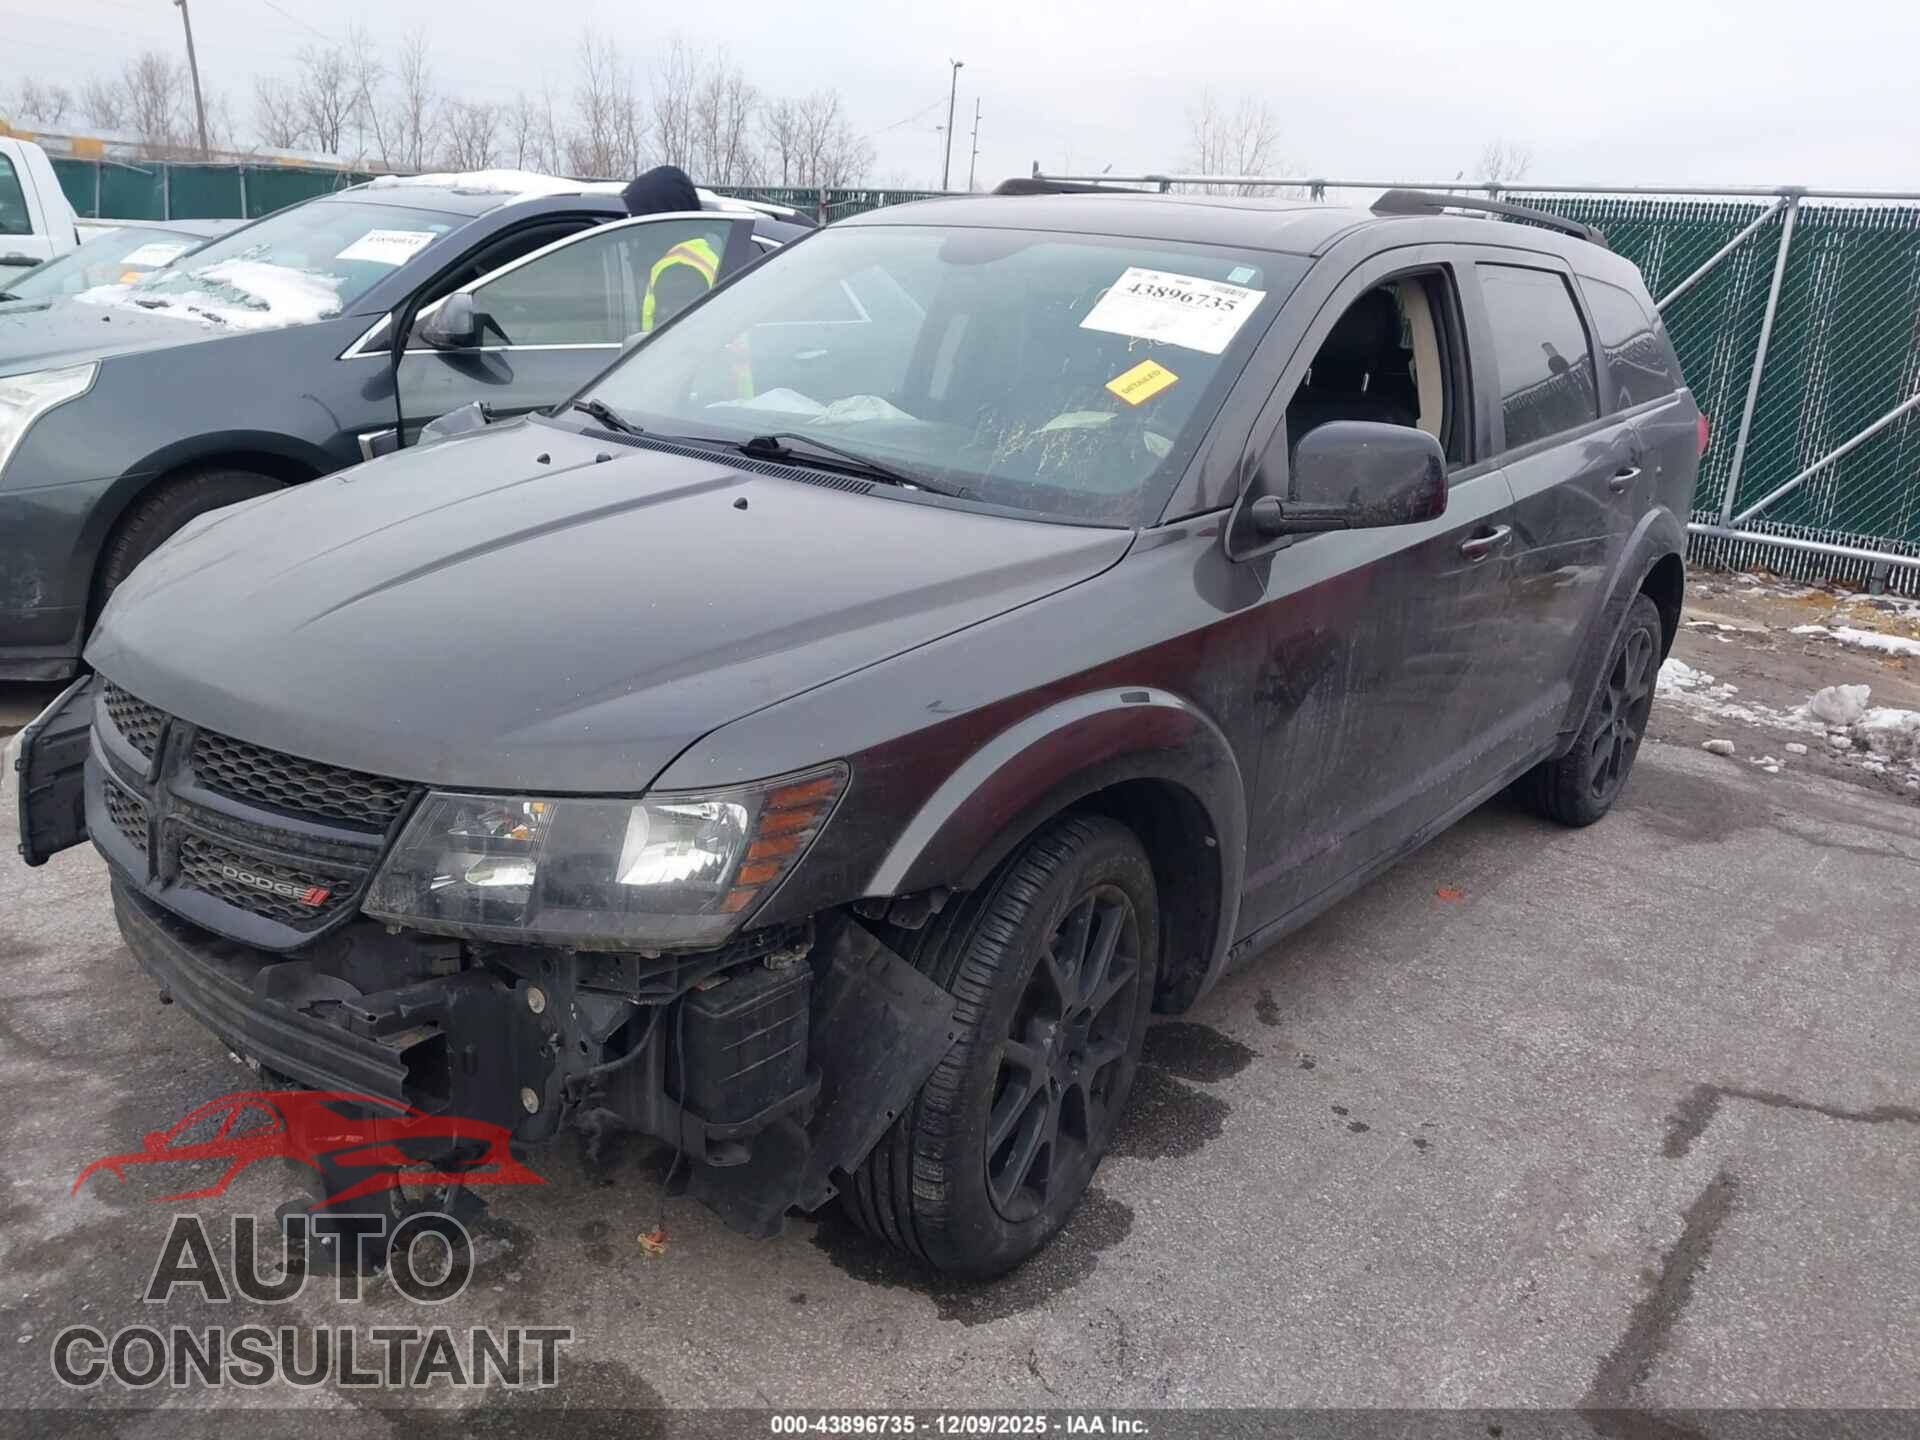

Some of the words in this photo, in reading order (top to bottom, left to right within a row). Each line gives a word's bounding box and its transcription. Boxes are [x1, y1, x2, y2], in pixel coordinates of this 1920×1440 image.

[1127, 282, 1238, 311] 43896735
[1121, 369, 1161, 394] DETAILED
[223, 866, 308, 899] DODGE
